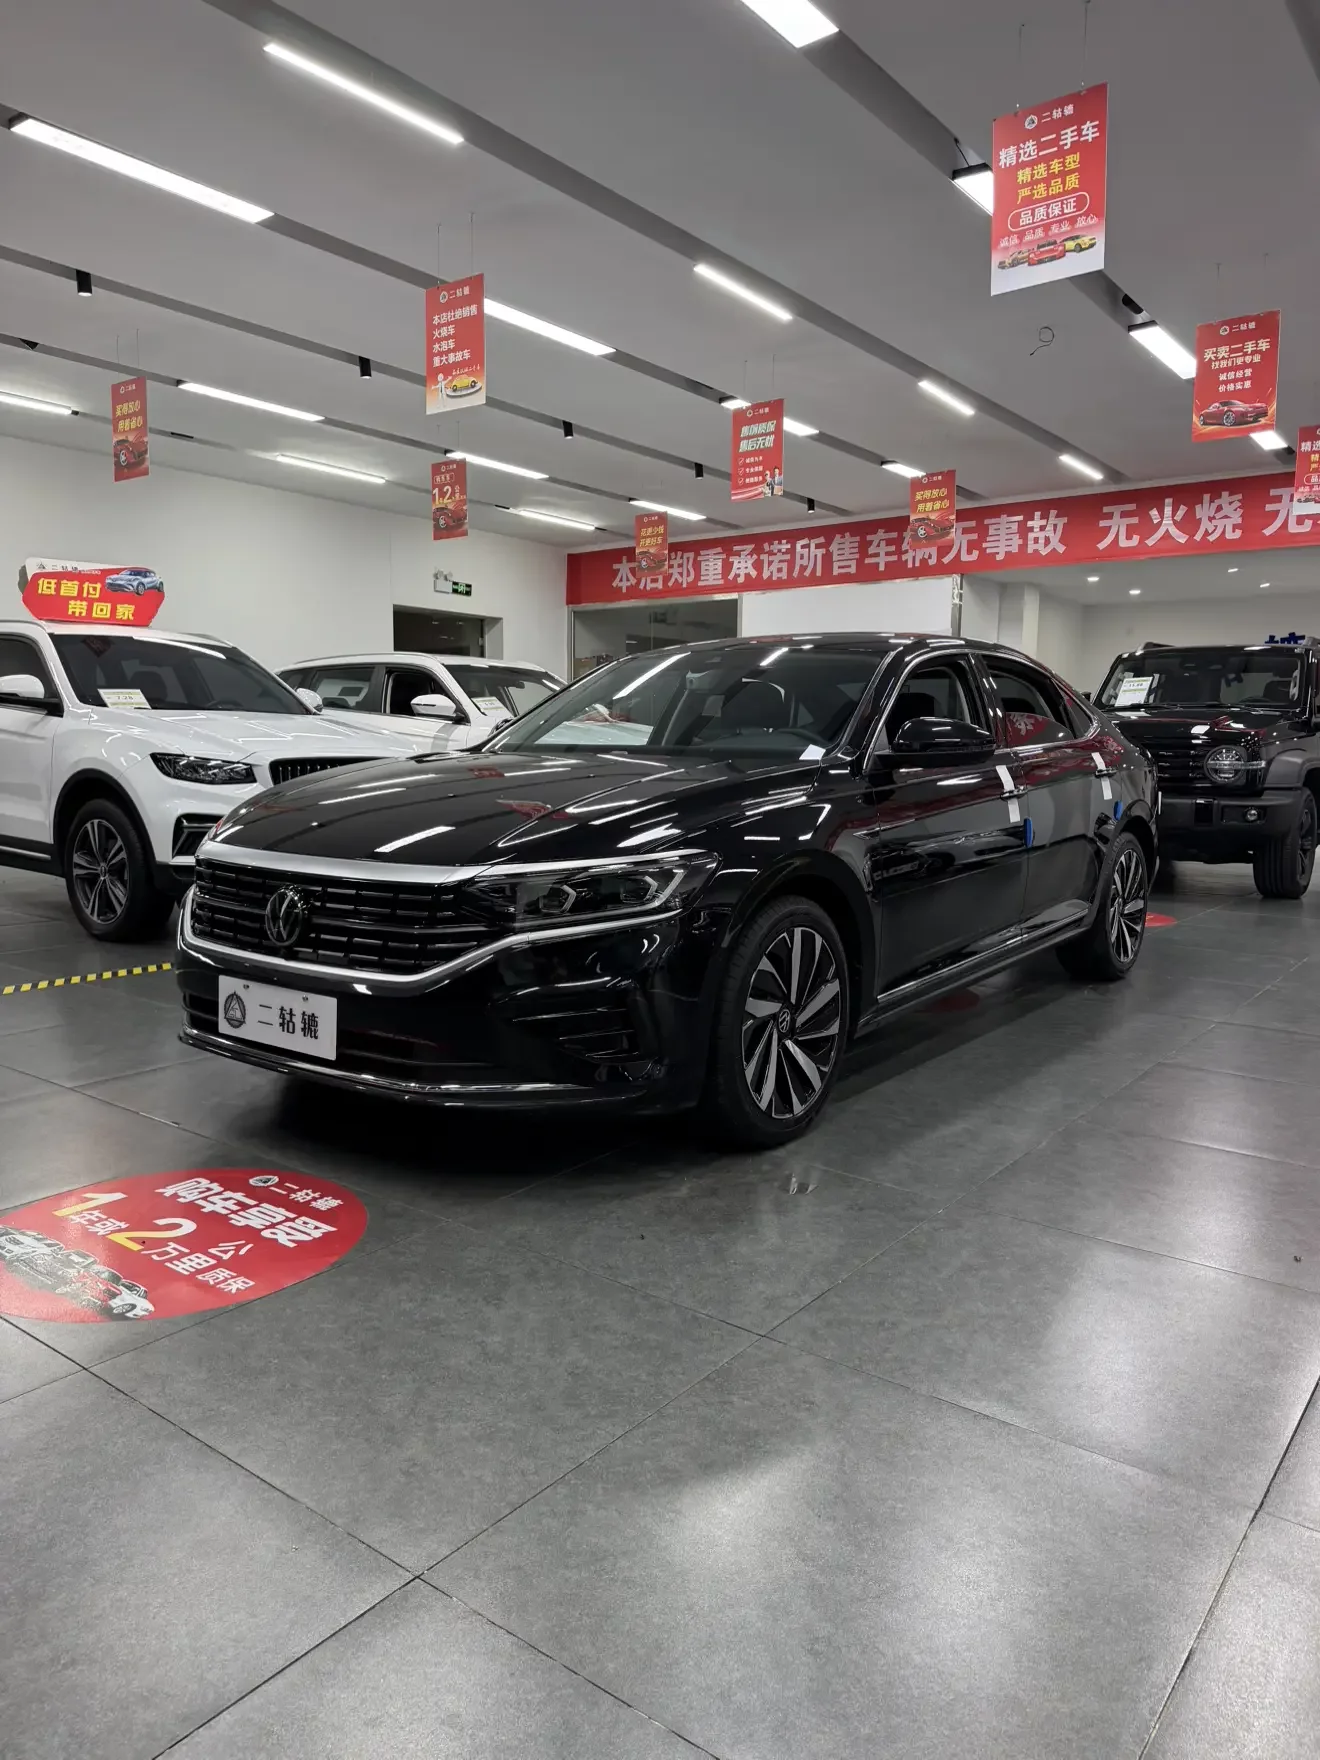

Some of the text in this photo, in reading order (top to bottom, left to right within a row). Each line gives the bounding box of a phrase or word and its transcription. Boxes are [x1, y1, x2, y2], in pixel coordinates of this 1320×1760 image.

[999, 120, 1100, 169] 精选二手车
[1016, 152, 1080, 185] 精选车型
[1016, 173, 1080, 205] 严选品质
[1019, 198, 1077, 226] 品质保证
[1023, 227, 1045, 242] 品质
[1049, 221, 1072, 236] 专业
[1075, 214, 1098, 228] 放心
[432, 304, 478, 326] 本店杜绝销售
[432, 325, 455, 340] 火烧车
[432, 339, 455, 353] 水泡车
[1203, 338, 1271, 362] 买卖二手车
[432, 349, 471, 368] 重大事故车
[1211, 353, 1261, 370] 找我们更专业
[1218, 368, 1252, 381] 诚信经营
[1218, 380, 1252, 393] 价格实惠
[115, 399, 140, 417] 买得放心
[915, 488, 947, 501] 买得放心
[917, 499, 949, 513] 用着省心
[1096, 491, 1244, 551] 无火烧
[1261, 486, 1320, 535] 无
[640, 524, 664, 537] 花更少钱
[639, 536, 663, 547] 开更好车
[37, 577, 102, 598] 低首付
[67, 600, 135, 621] 带回家
[257, 1004, 319, 1040] 二轱辘
[268, 1182, 344, 1211] 二轱辘
[154, 1177, 338, 1248] 购车享受
